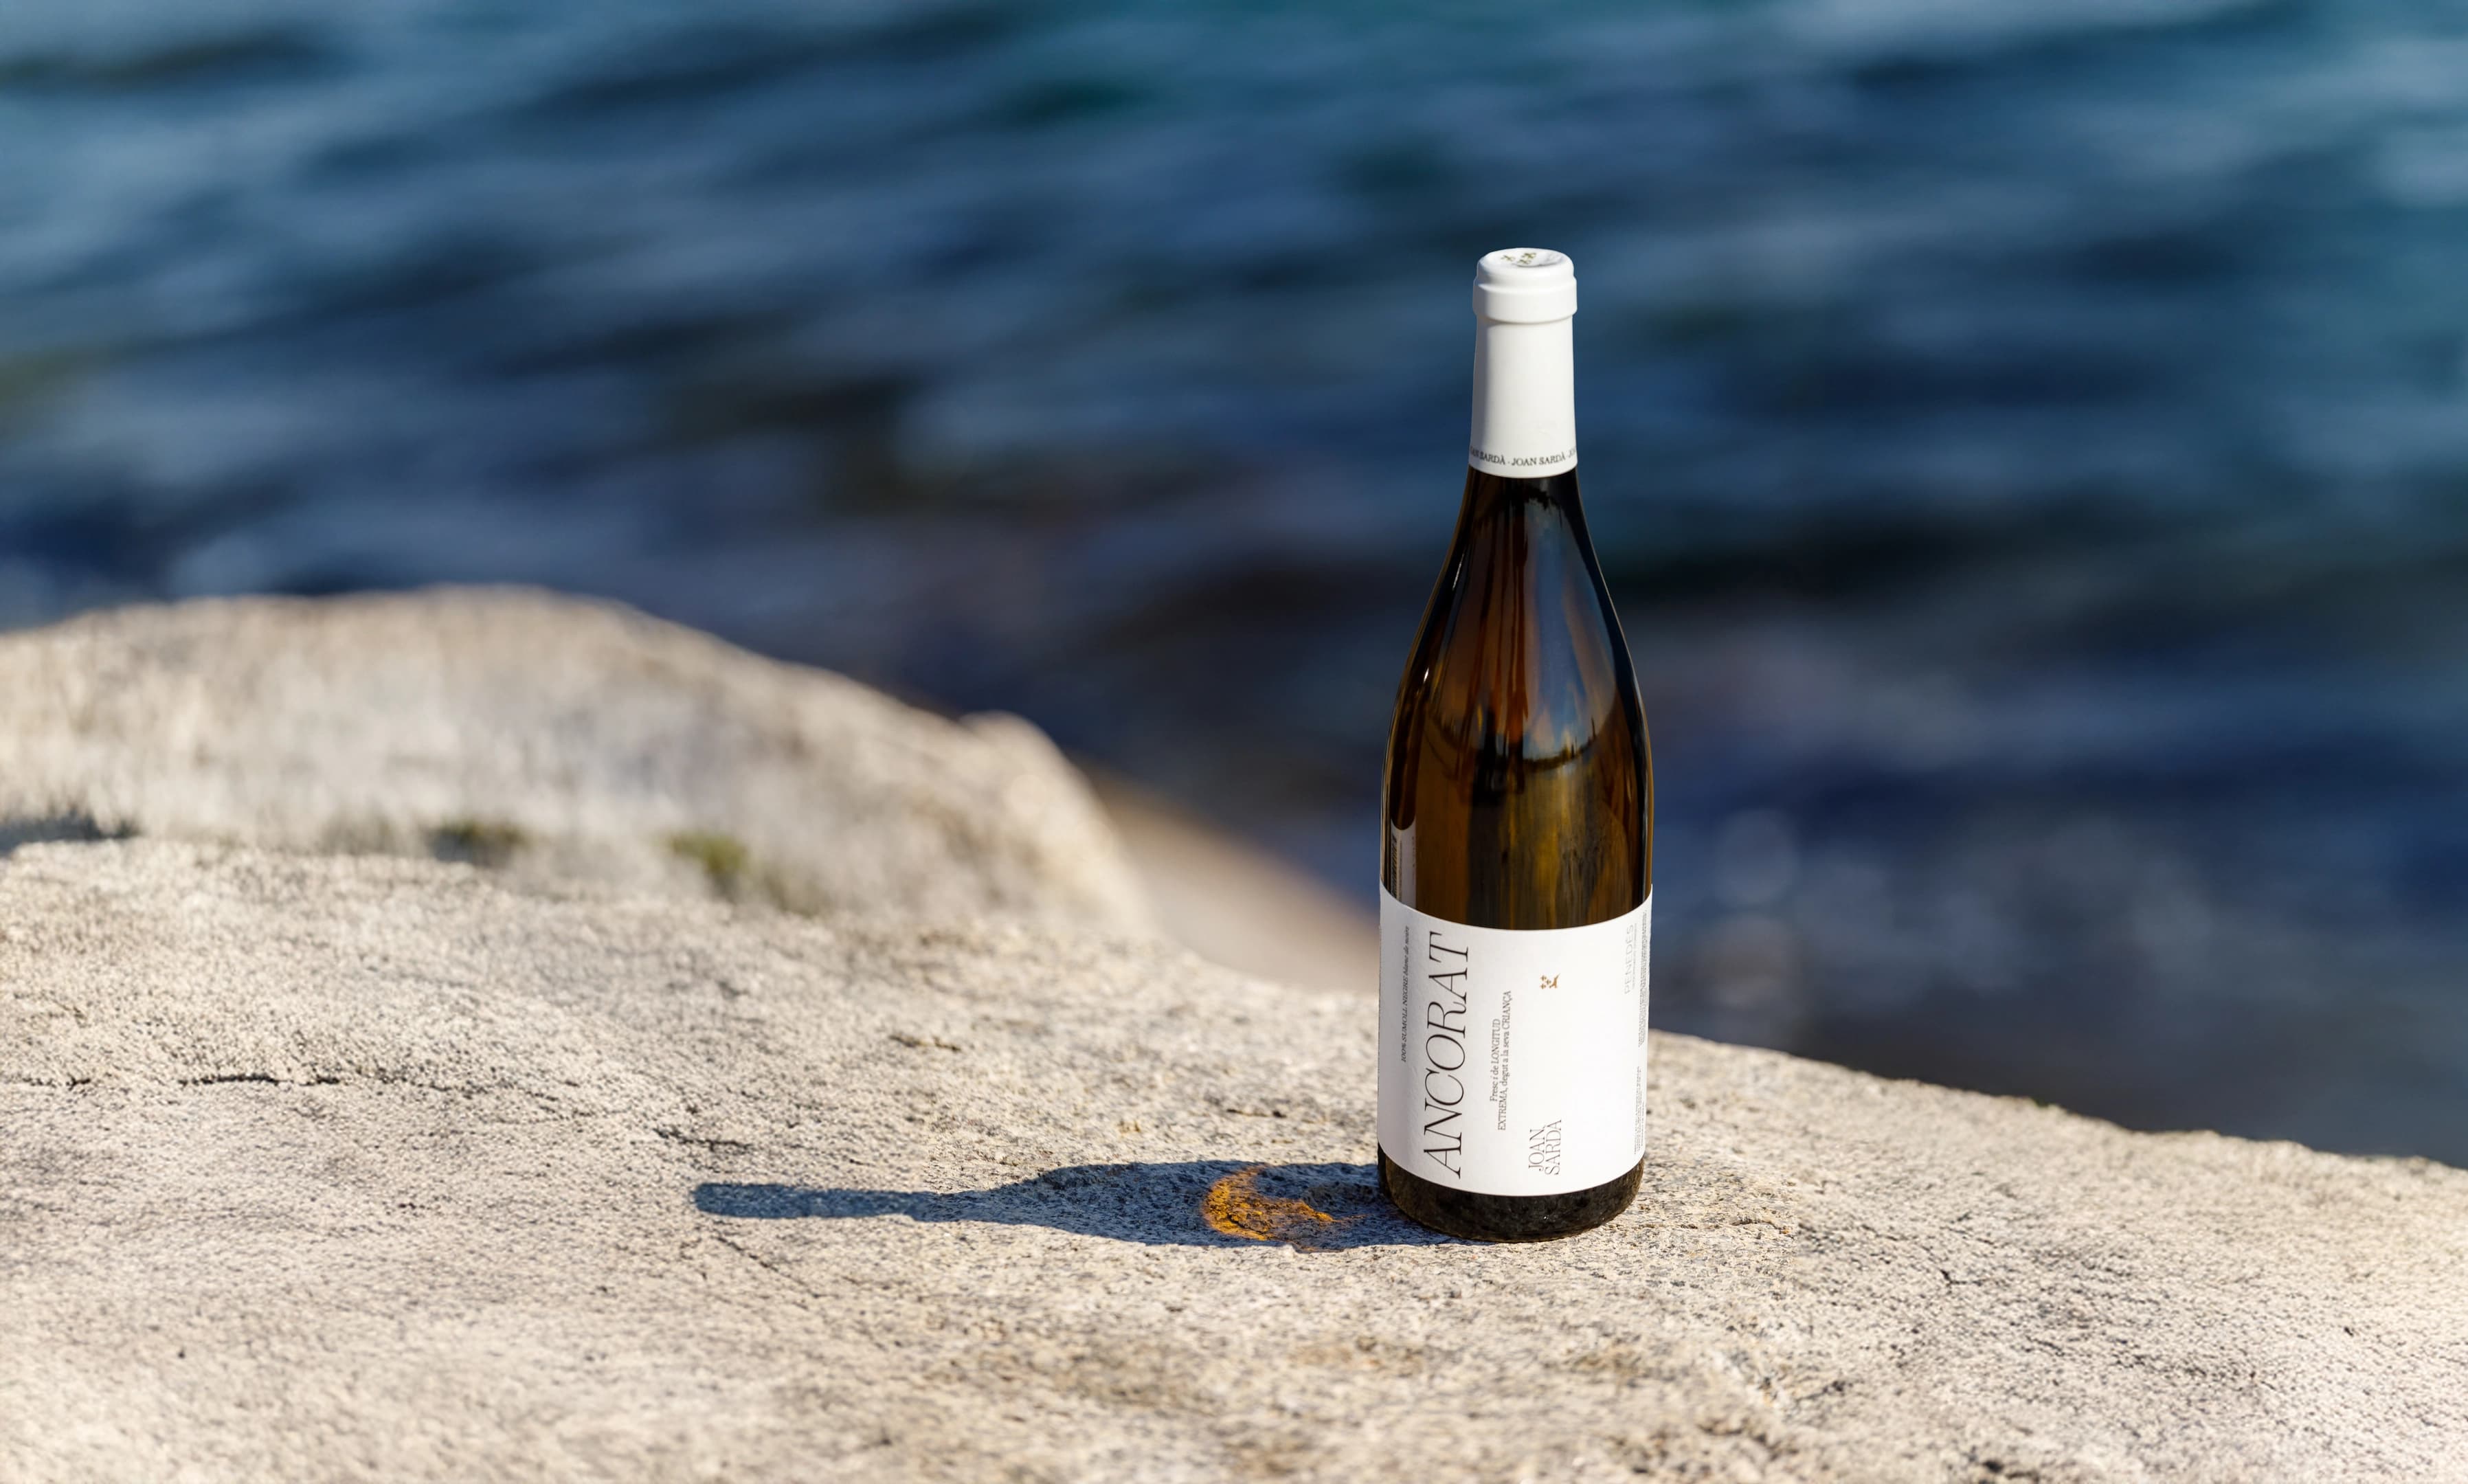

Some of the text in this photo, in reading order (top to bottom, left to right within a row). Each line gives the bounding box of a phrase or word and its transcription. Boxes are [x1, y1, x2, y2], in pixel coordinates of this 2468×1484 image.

[1479, 451, 1505, 465] SARDÀ
[1512, 458, 1537, 466] JOAN
[1538, 451, 1566, 465] SARDÀ
[1501, 990, 1512, 1030] CRIANÇA
[1424, 931, 1469, 1178] ANCORAT
[1491, 1018, 1501, 1064] LONGITUD
[1490, 1065, 1499, 1075] de
[1500, 1064, 1510, 1086] degut
[1490, 1081, 1499, 1101] Fresc
[1497, 1088, 1508, 1131] EXTREMA,
[1529, 1129, 1544, 1171] JOAN
[1543, 1119, 1562, 1176] SARDÀ
